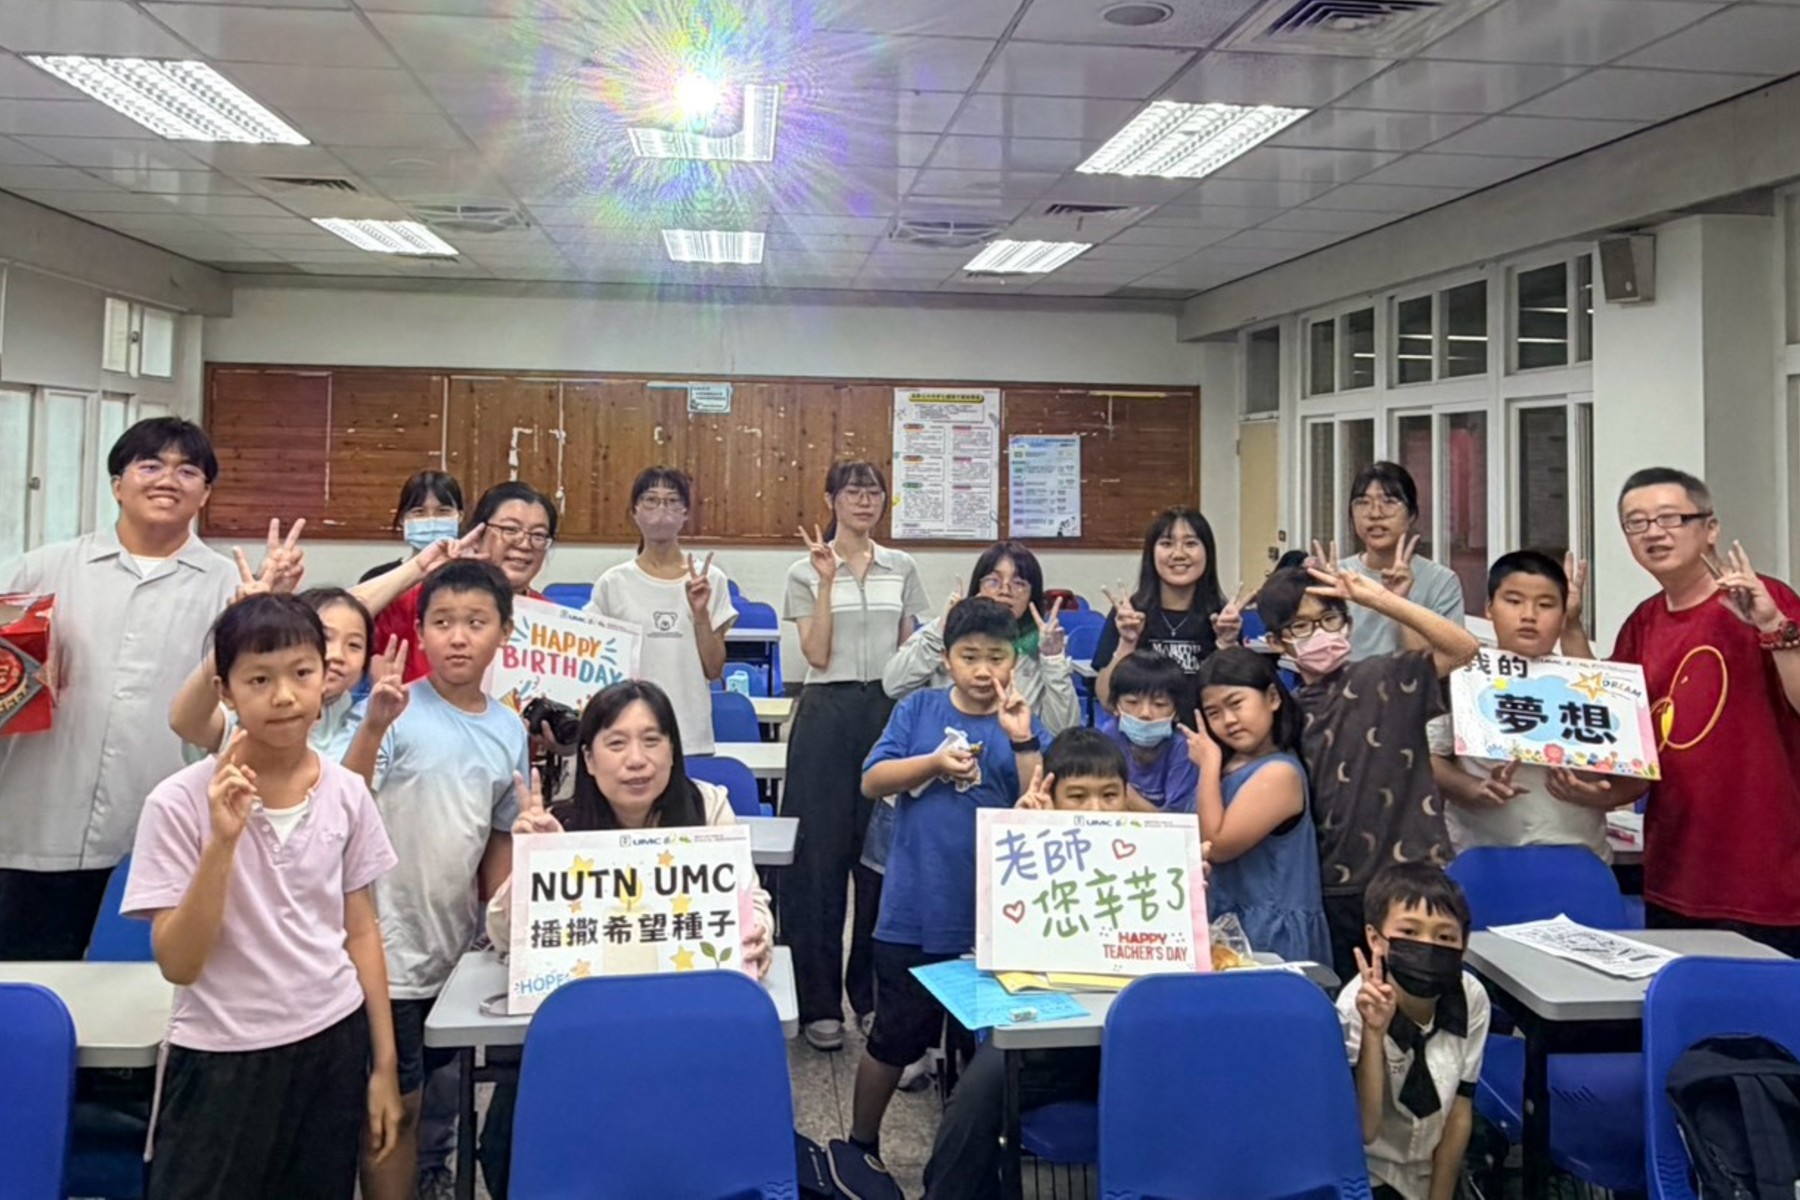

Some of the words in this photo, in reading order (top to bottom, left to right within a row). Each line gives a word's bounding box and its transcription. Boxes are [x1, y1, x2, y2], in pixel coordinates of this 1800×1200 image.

[531, 622, 602, 659] HAPPY
[502, 645, 623, 688] BIRTHDAY
[1494, 694, 1618, 745] 夢想
[995, 828, 1092, 886] 老師
[531, 867, 638, 902] NUTN
[654, 863, 736, 896] UMC
[1032, 866, 1185, 938] 您辛苦了
[530, 910, 736, 948] 播撒希望種子
[1118, 932, 1168, 944] HAPPY
[1103, 944, 1163, 961] TEACHER'S
[1166, 947, 1188, 961] DAY
